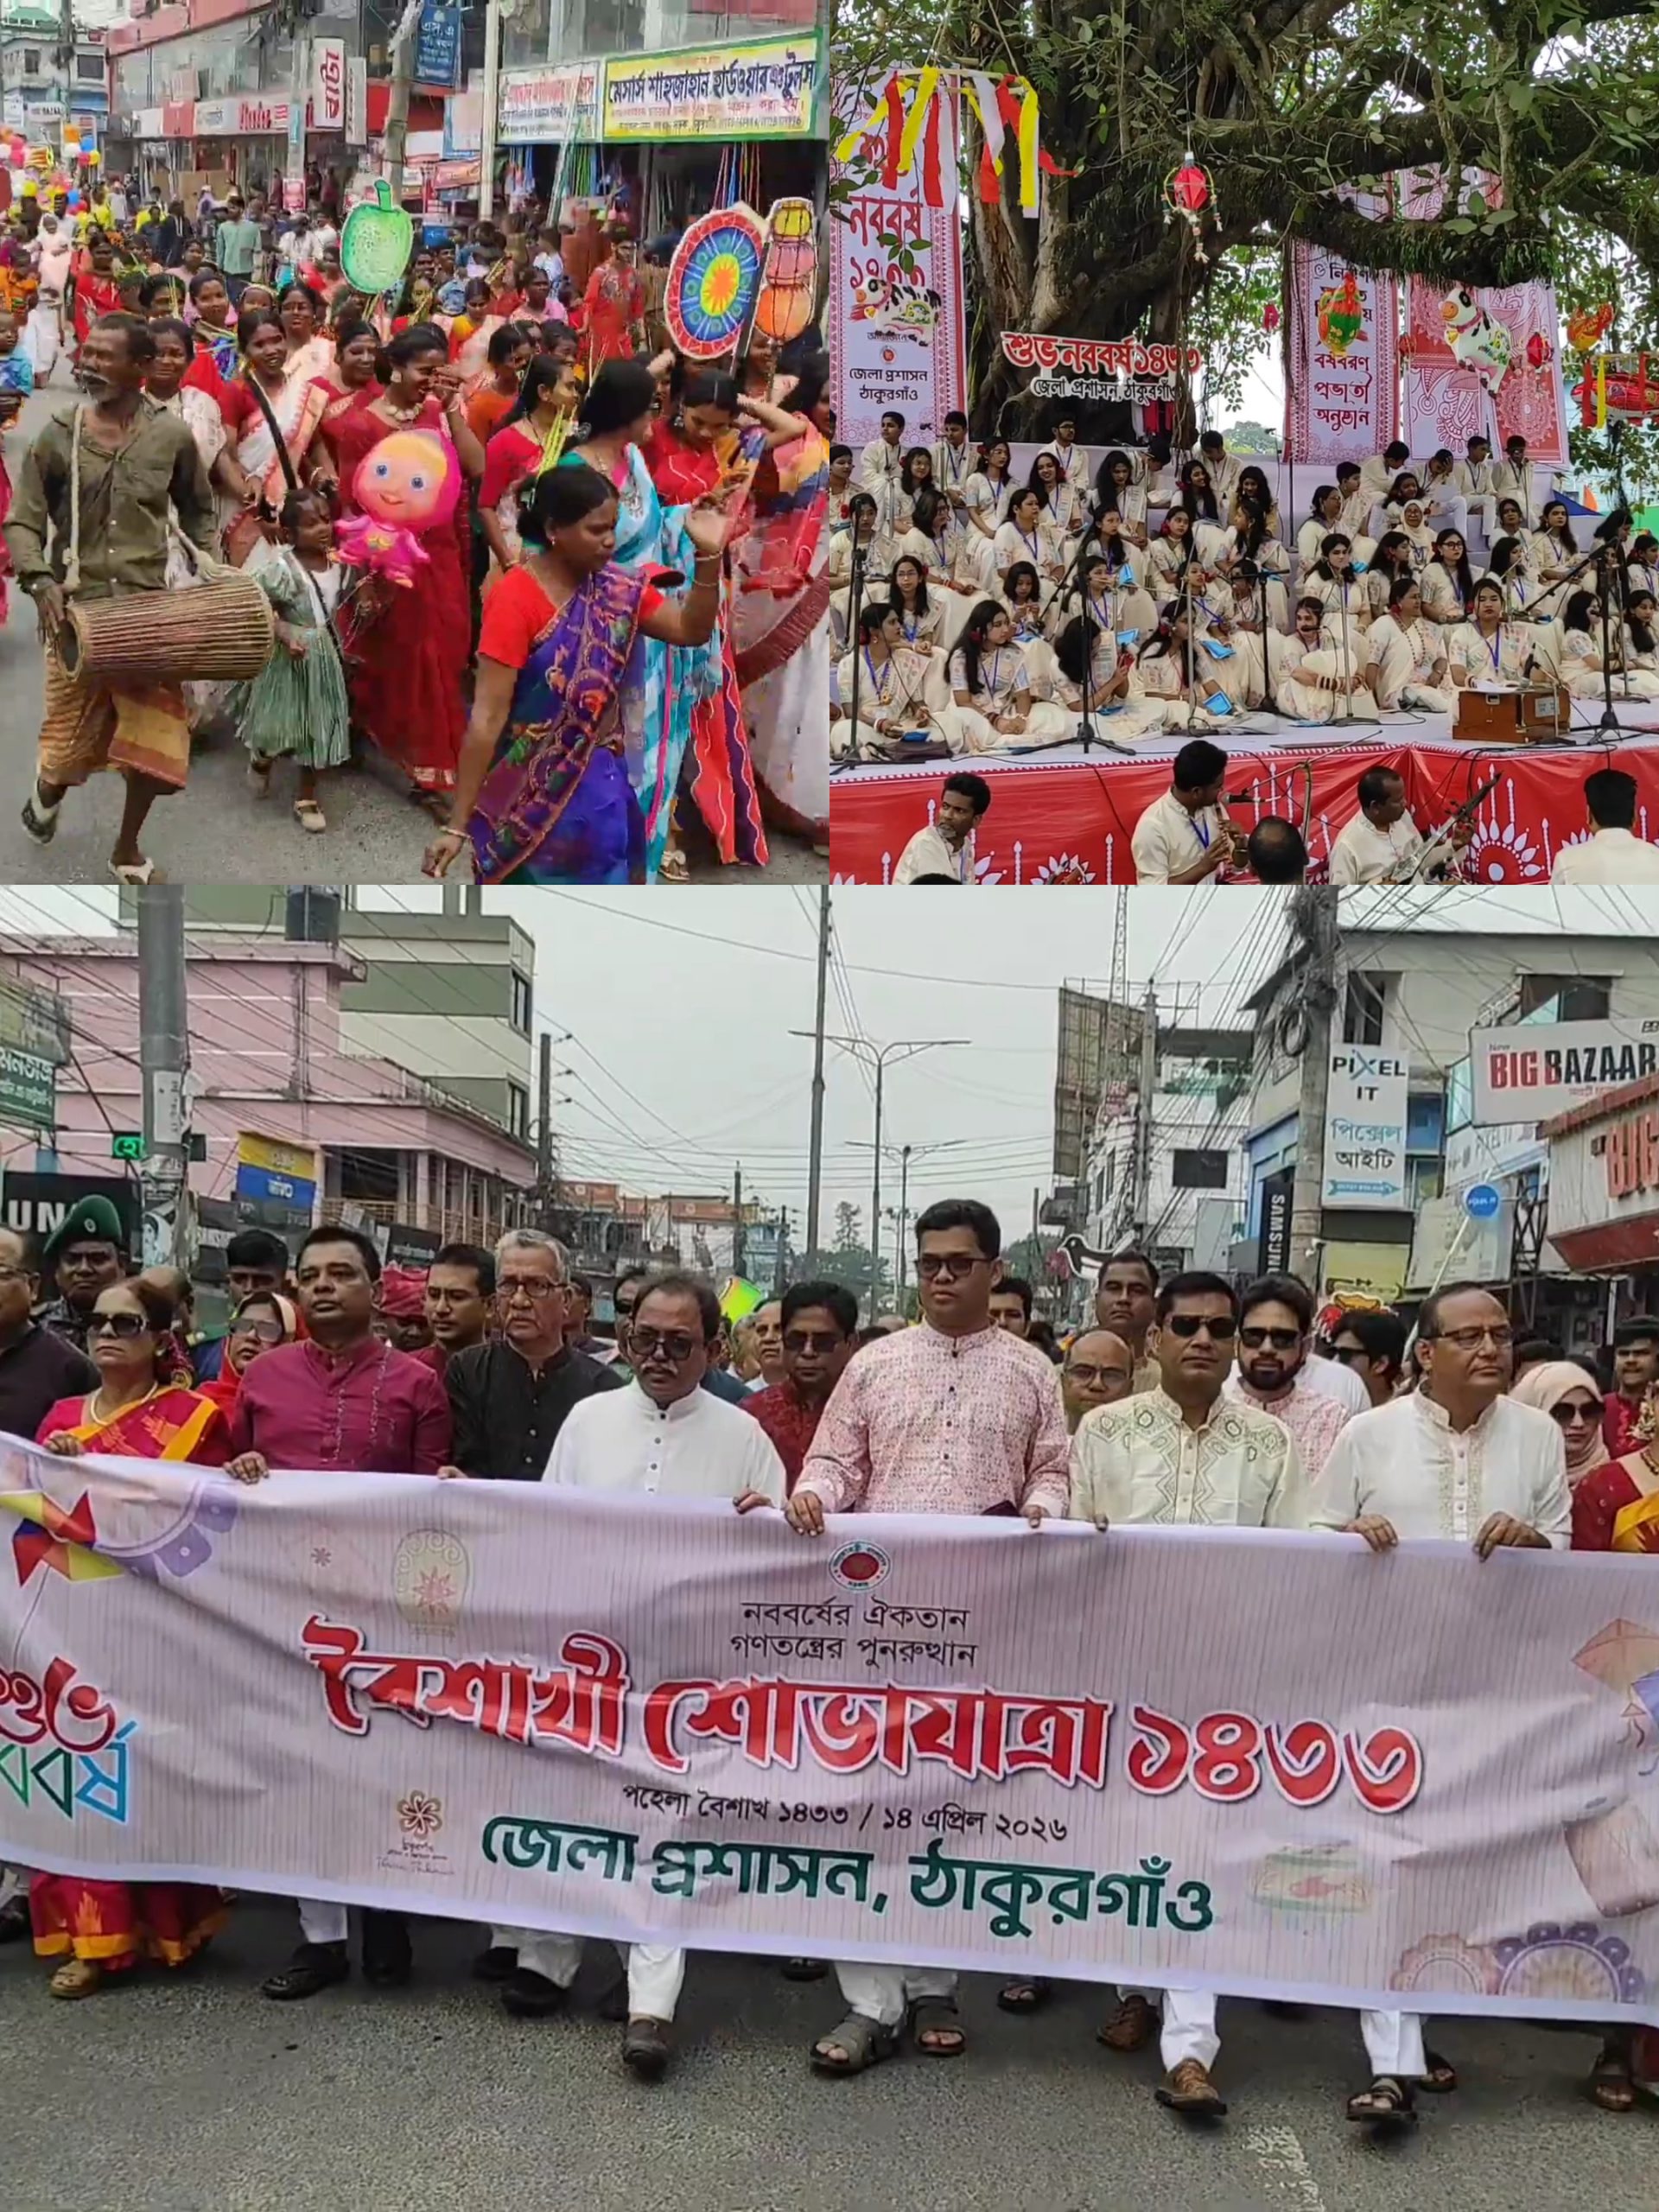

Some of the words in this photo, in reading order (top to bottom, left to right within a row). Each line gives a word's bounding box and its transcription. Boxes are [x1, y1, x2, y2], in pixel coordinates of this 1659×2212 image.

[320, 48, 340, 119] বাটা
[609, 69, 645, 104] মেসার্স
[648, 68, 710, 109] শাহজাহান
[847, 187, 923, 248] নববর্ষ
[1002, 333, 1059, 367] শুভ
[1062, 335, 1135, 374] নববর্ষ
[849, 367, 883, 381] জেলা
[885, 369, 928, 383] প্রশাসন
[1034, 378, 1065, 399] জেলা
[1313, 370, 1372, 404] প্রভাতী
[859, 385, 918, 404] ঠাকুরগাঁও
[1313, 407, 1370, 434] অনুষ্ঠান
[1490, 1050, 1539, 1090] BIG
[1544, 1042, 1656, 1085] BAZAAR
[1357, 1086, 1379, 1101] IT
[1335, 1147, 1395, 1170] আইটি
[9, 1199, 78, 1233] UN
[741, 1596, 854, 1627] নববর্ষের
[864, 1596, 970, 1631] ঐকতান
[731, 1633, 847, 1660] গণতন্ত্রের
[856, 1637, 978, 1669] পুনরুত্থান
[302, 1614, 632, 1755] বৈশাখী
[645, 1675, 1113, 1789] শোভাযাত্রা
[1128, 1705, 1424, 1814] ১৪৩৩
[622, 1783, 691, 1816] পহেলা
[696, 1787, 768, 1821] বৈশাখ
[779, 1802, 849, 1825] ১৪৩৩
[859, 1802, 874, 1831] /
[883, 1806, 912, 1830] ১৪
[922, 1802, 987, 1836] এপ্রিল
[995, 1815, 1068, 1842] ২০২৬
[481, 1815, 639, 1883] জেলা
[651, 1838, 887, 1915] প্রশাসন,
[908, 1837, 1214, 1939] ঠাকুরগাঁও
